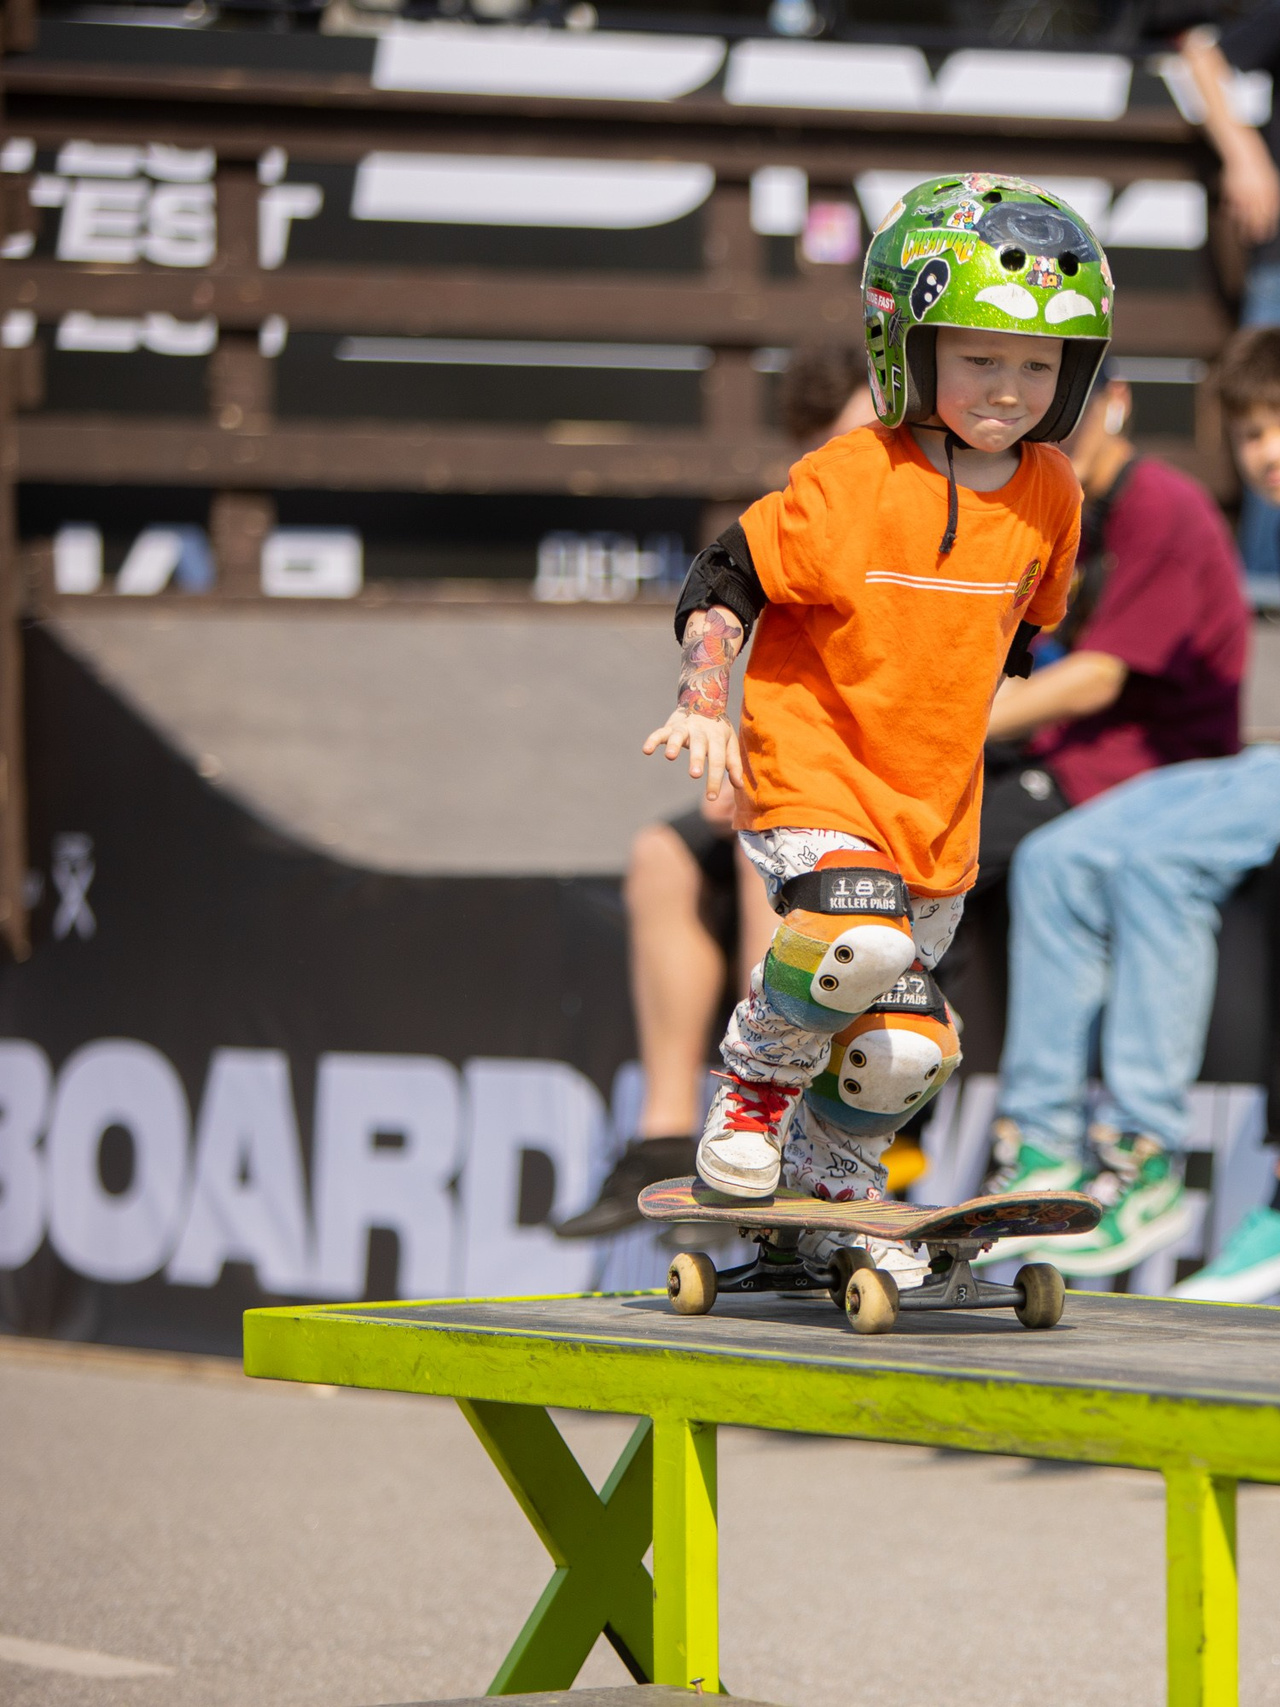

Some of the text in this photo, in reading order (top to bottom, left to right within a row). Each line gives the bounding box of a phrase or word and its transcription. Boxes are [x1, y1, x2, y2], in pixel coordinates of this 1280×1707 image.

[902, 230, 978, 268] CREATURE
[878, 295, 894, 310] FAST
[834, 877, 895, 898] 187
[830, 897, 896, 910] KILLER PADS
[902, 993, 928, 1005] PADS
